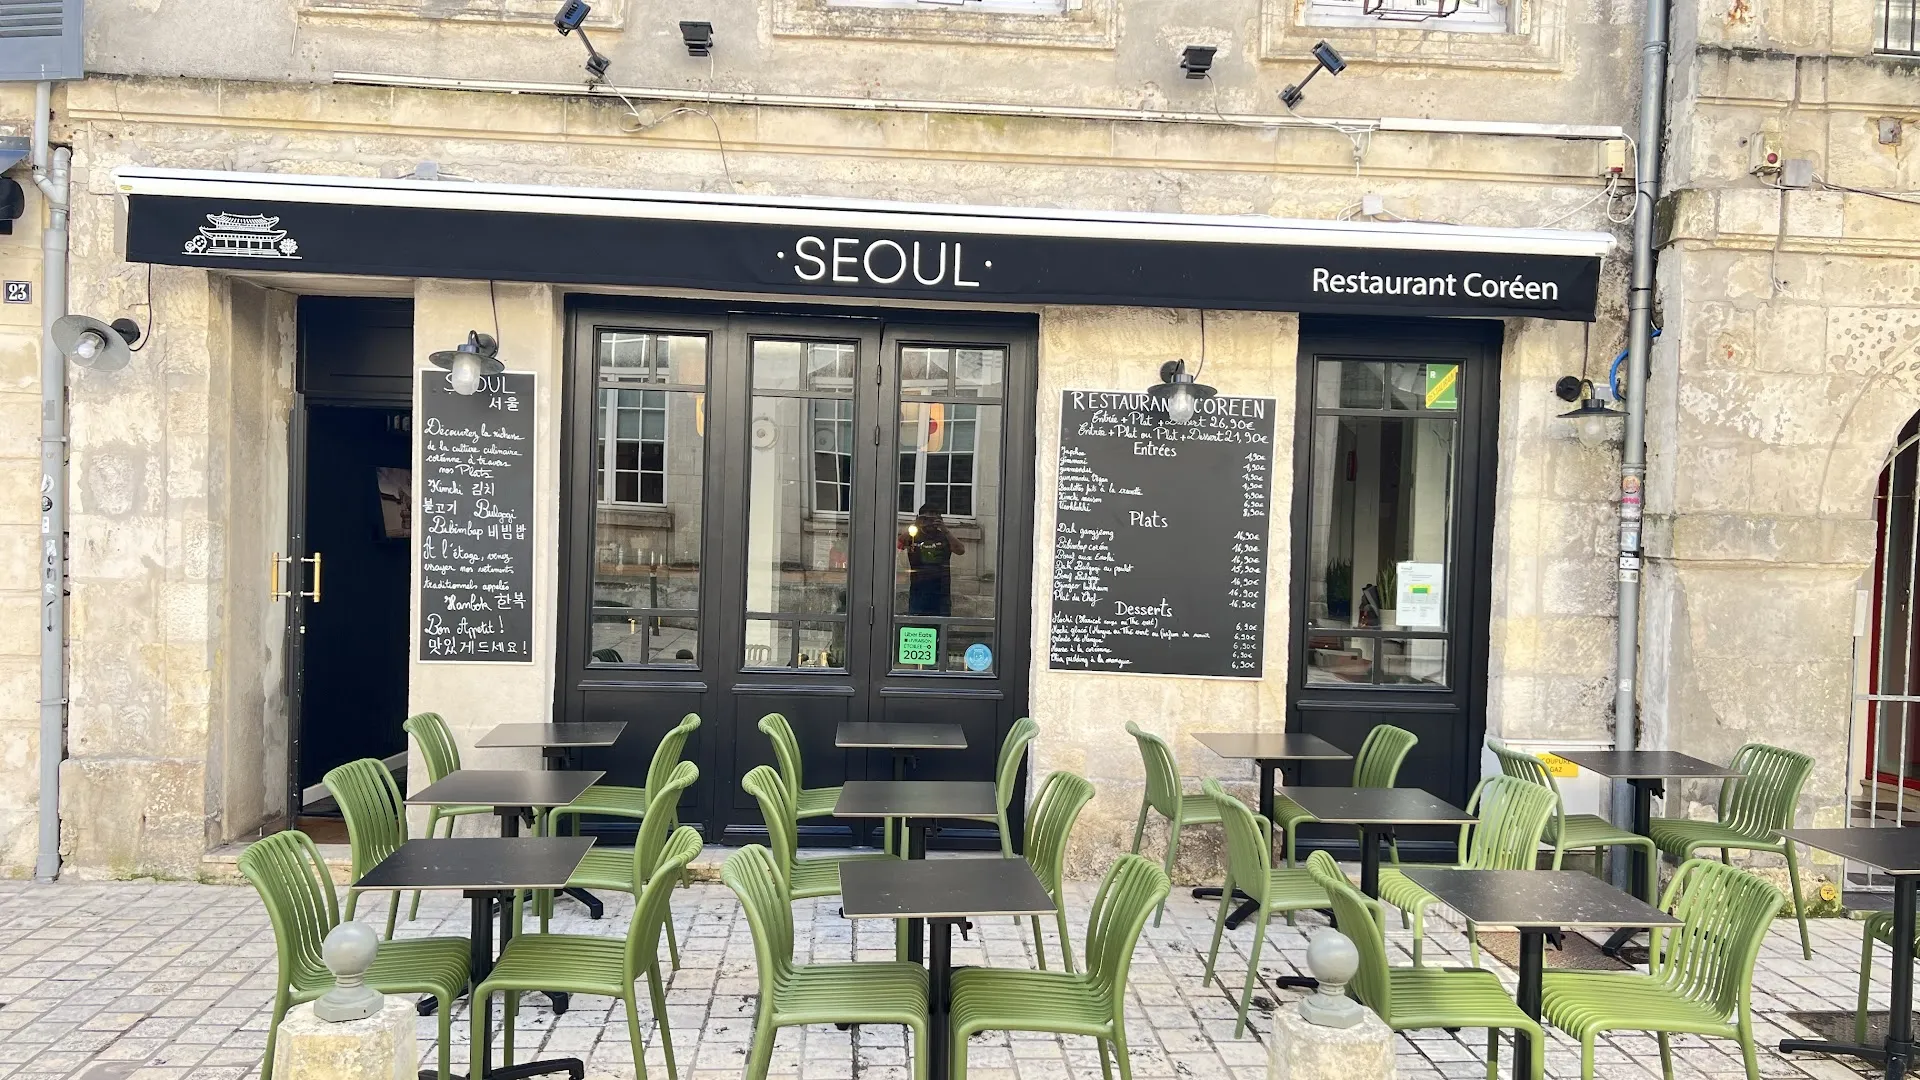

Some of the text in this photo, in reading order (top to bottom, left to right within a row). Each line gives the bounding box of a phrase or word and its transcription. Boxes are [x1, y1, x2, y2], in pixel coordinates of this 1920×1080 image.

[794, 236, 980, 287] SEOUL
[8, 284, 27, 300] 23
[1313, 268, 1559, 300] Restaurant Coréen
[444, 373, 516, 394] SOUL
[1071, 391, 1264, 419] RESTAURAN COREEN
[1091, 409, 1119, 424] Entrée
[1128, 411, 1153, 426] Plat
[1210, 416, 1255, 431] 26,90€
[424, 418, 480, 443] Découvrez
[481, 423, 491, 437] la
[493, 427, 525, 440] richesse
[1078, 421, 1106, 436] Entrée
[1114, 424, 1137, 437] Plat
[1153, 426, 1178, 441] Plat
[1224, 430, 1269, 443] 21,90€
[427, 440, 522, 456] de la culture culinaire
[1133, 441, 1177, 457] Entrées
[468, 454, 475, 465] à
[477, 455, 511, 467] travers
[439, 464, 494, 478] nos Plats
[428, 480, 463, 496] Kimchi
[472, 481, 495, 496] 김치
[423, 497, 457, 515] 불고기
[474, 498, 516, 523] Bulgogi
[1128, 510, 1168, 528] Plats
[429, 516, 483, 540] Bibimbap
[488, 524, 526, 540] 비빔밥
[487, 553, 513, 564] venez
[424, 563, 456, 575] essayer
[460, 565, 473, 573] nos
[423, 576, 509, 592] traditionnels appelés
[444, 593, 492, 611] Hanbok
[494, 592, 526, 609] 한복
[1072, 592, 1080, 601] du
[1114, 598, 1172, 617] Desserts
[424, 613, 450, 635] Bon
[903, 650, 931, 660] 2023
